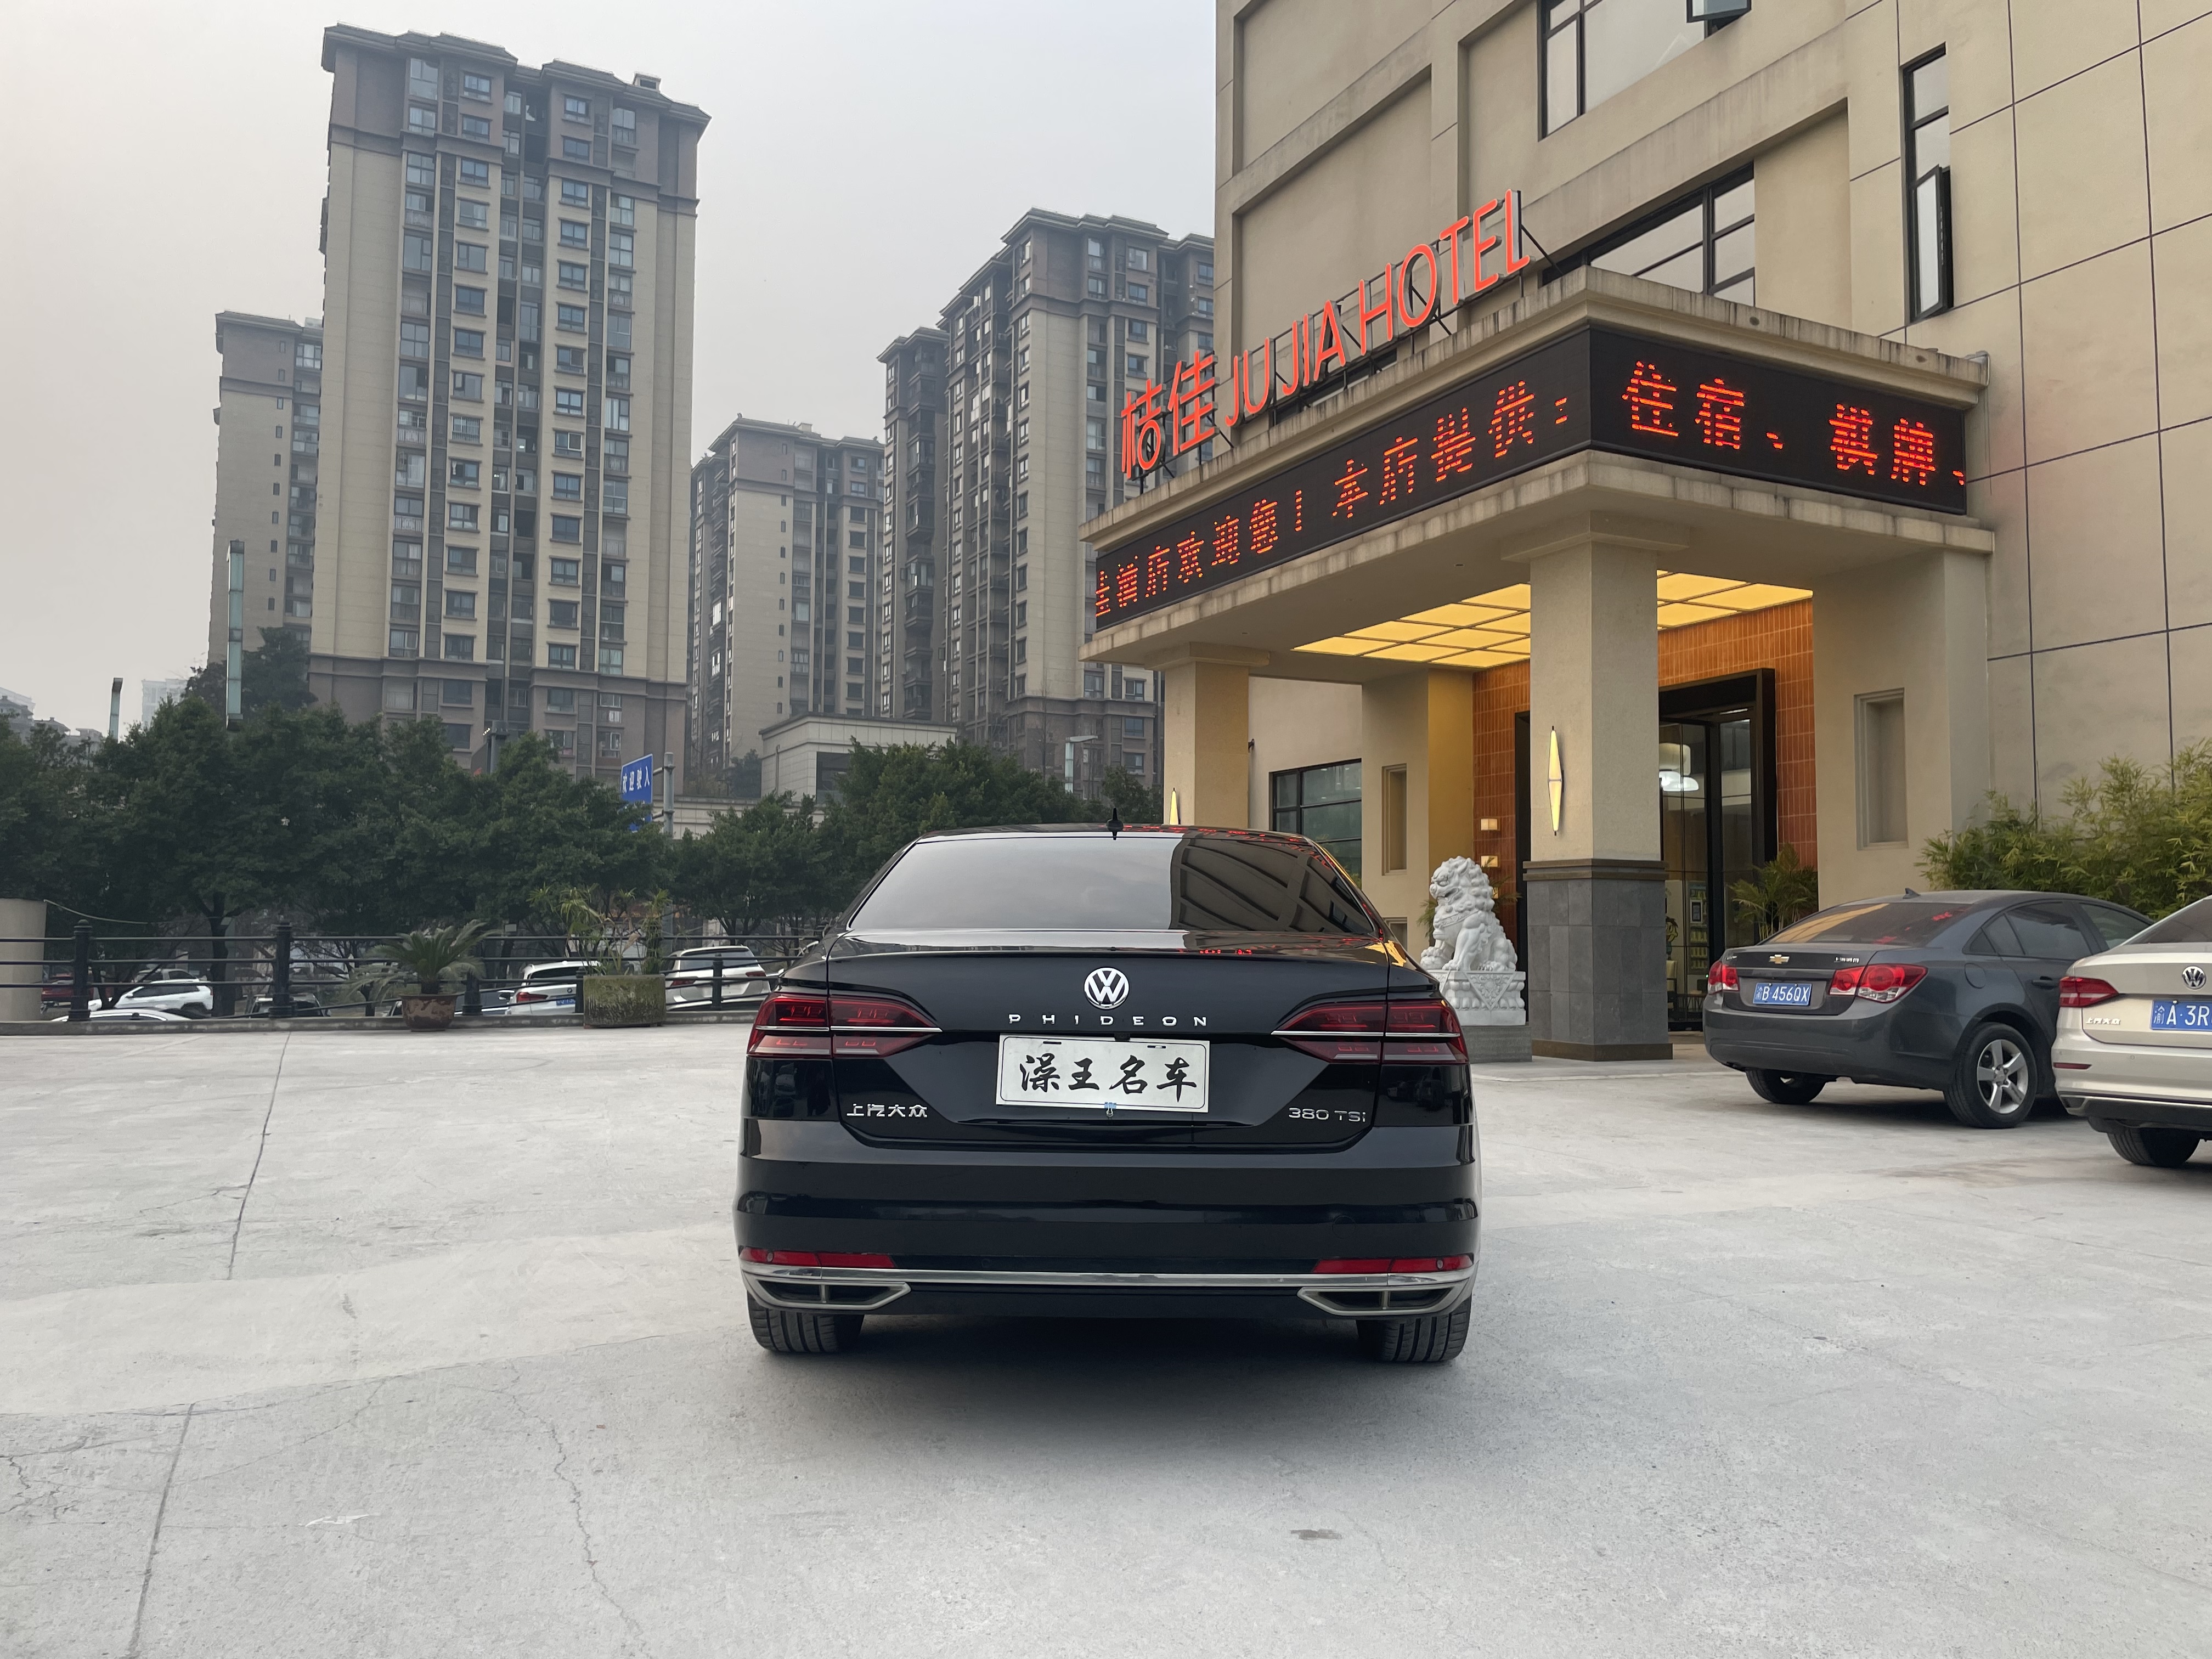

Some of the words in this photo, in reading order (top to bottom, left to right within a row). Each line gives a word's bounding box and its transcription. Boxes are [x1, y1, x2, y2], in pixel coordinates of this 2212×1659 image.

[1121, 350, 1216, 479] 桔佳
[1224, 300, 1346, 427] JUJIA
[1359, 189, 1530, 356] HOTEL
[622, 765, 650, 794] 欢迎驶入
[1008, 1014, 1207, 1027] PHIDEON
[2153, 1005, 2212, 1026] 渝A·3R
[847, 1103, 928, 1118] 上汽大众
[1289, 1108, 1329, 1120] 380
